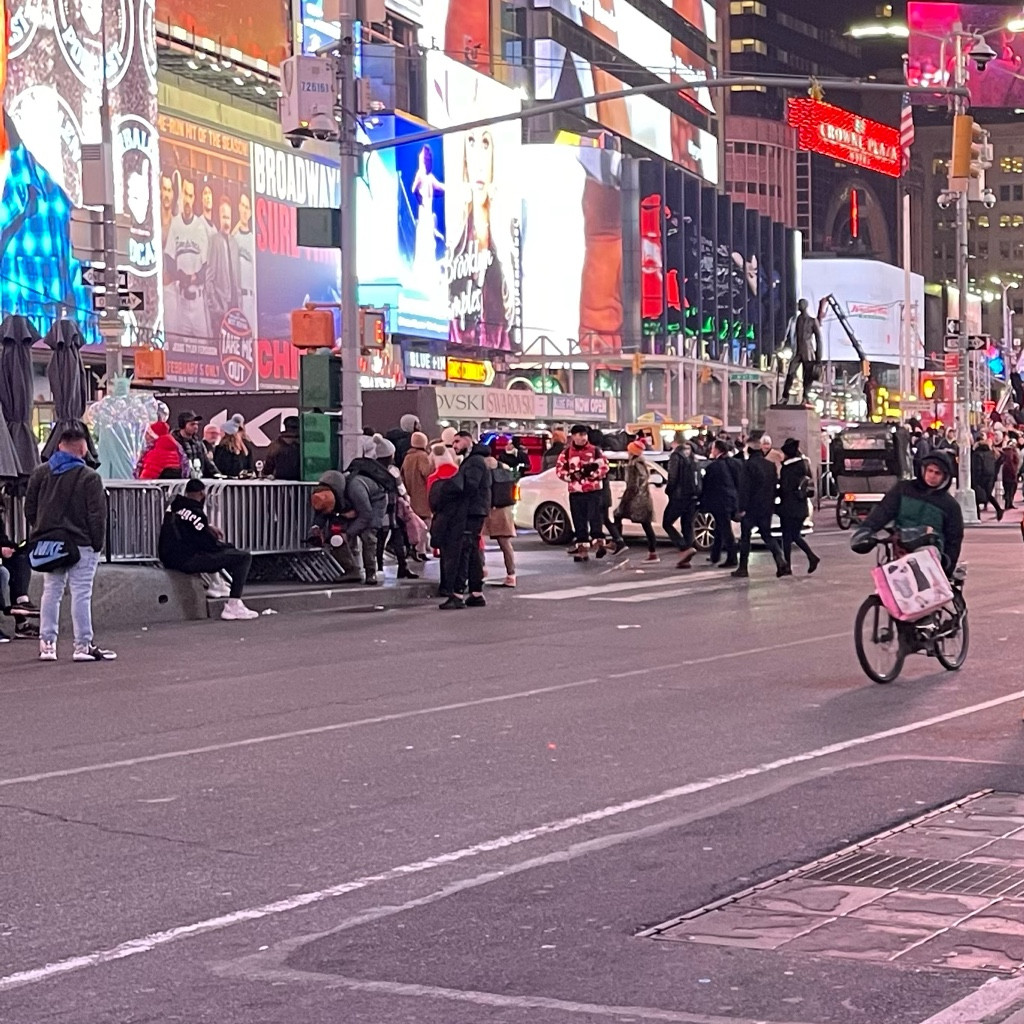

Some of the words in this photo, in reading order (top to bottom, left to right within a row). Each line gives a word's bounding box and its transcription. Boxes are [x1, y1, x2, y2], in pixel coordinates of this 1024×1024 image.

[819, 123, 863, 149] CROWNE
[867, 138, 897, 160] PLAZA
[254, 142, 341, 209] BROADWAY'
[221, 328, 241, 356] TAKE
[241, 337, 253, 363] ME
[410, 351, 431, 369] BLUE
[228, 361, 245, 382] OUT
